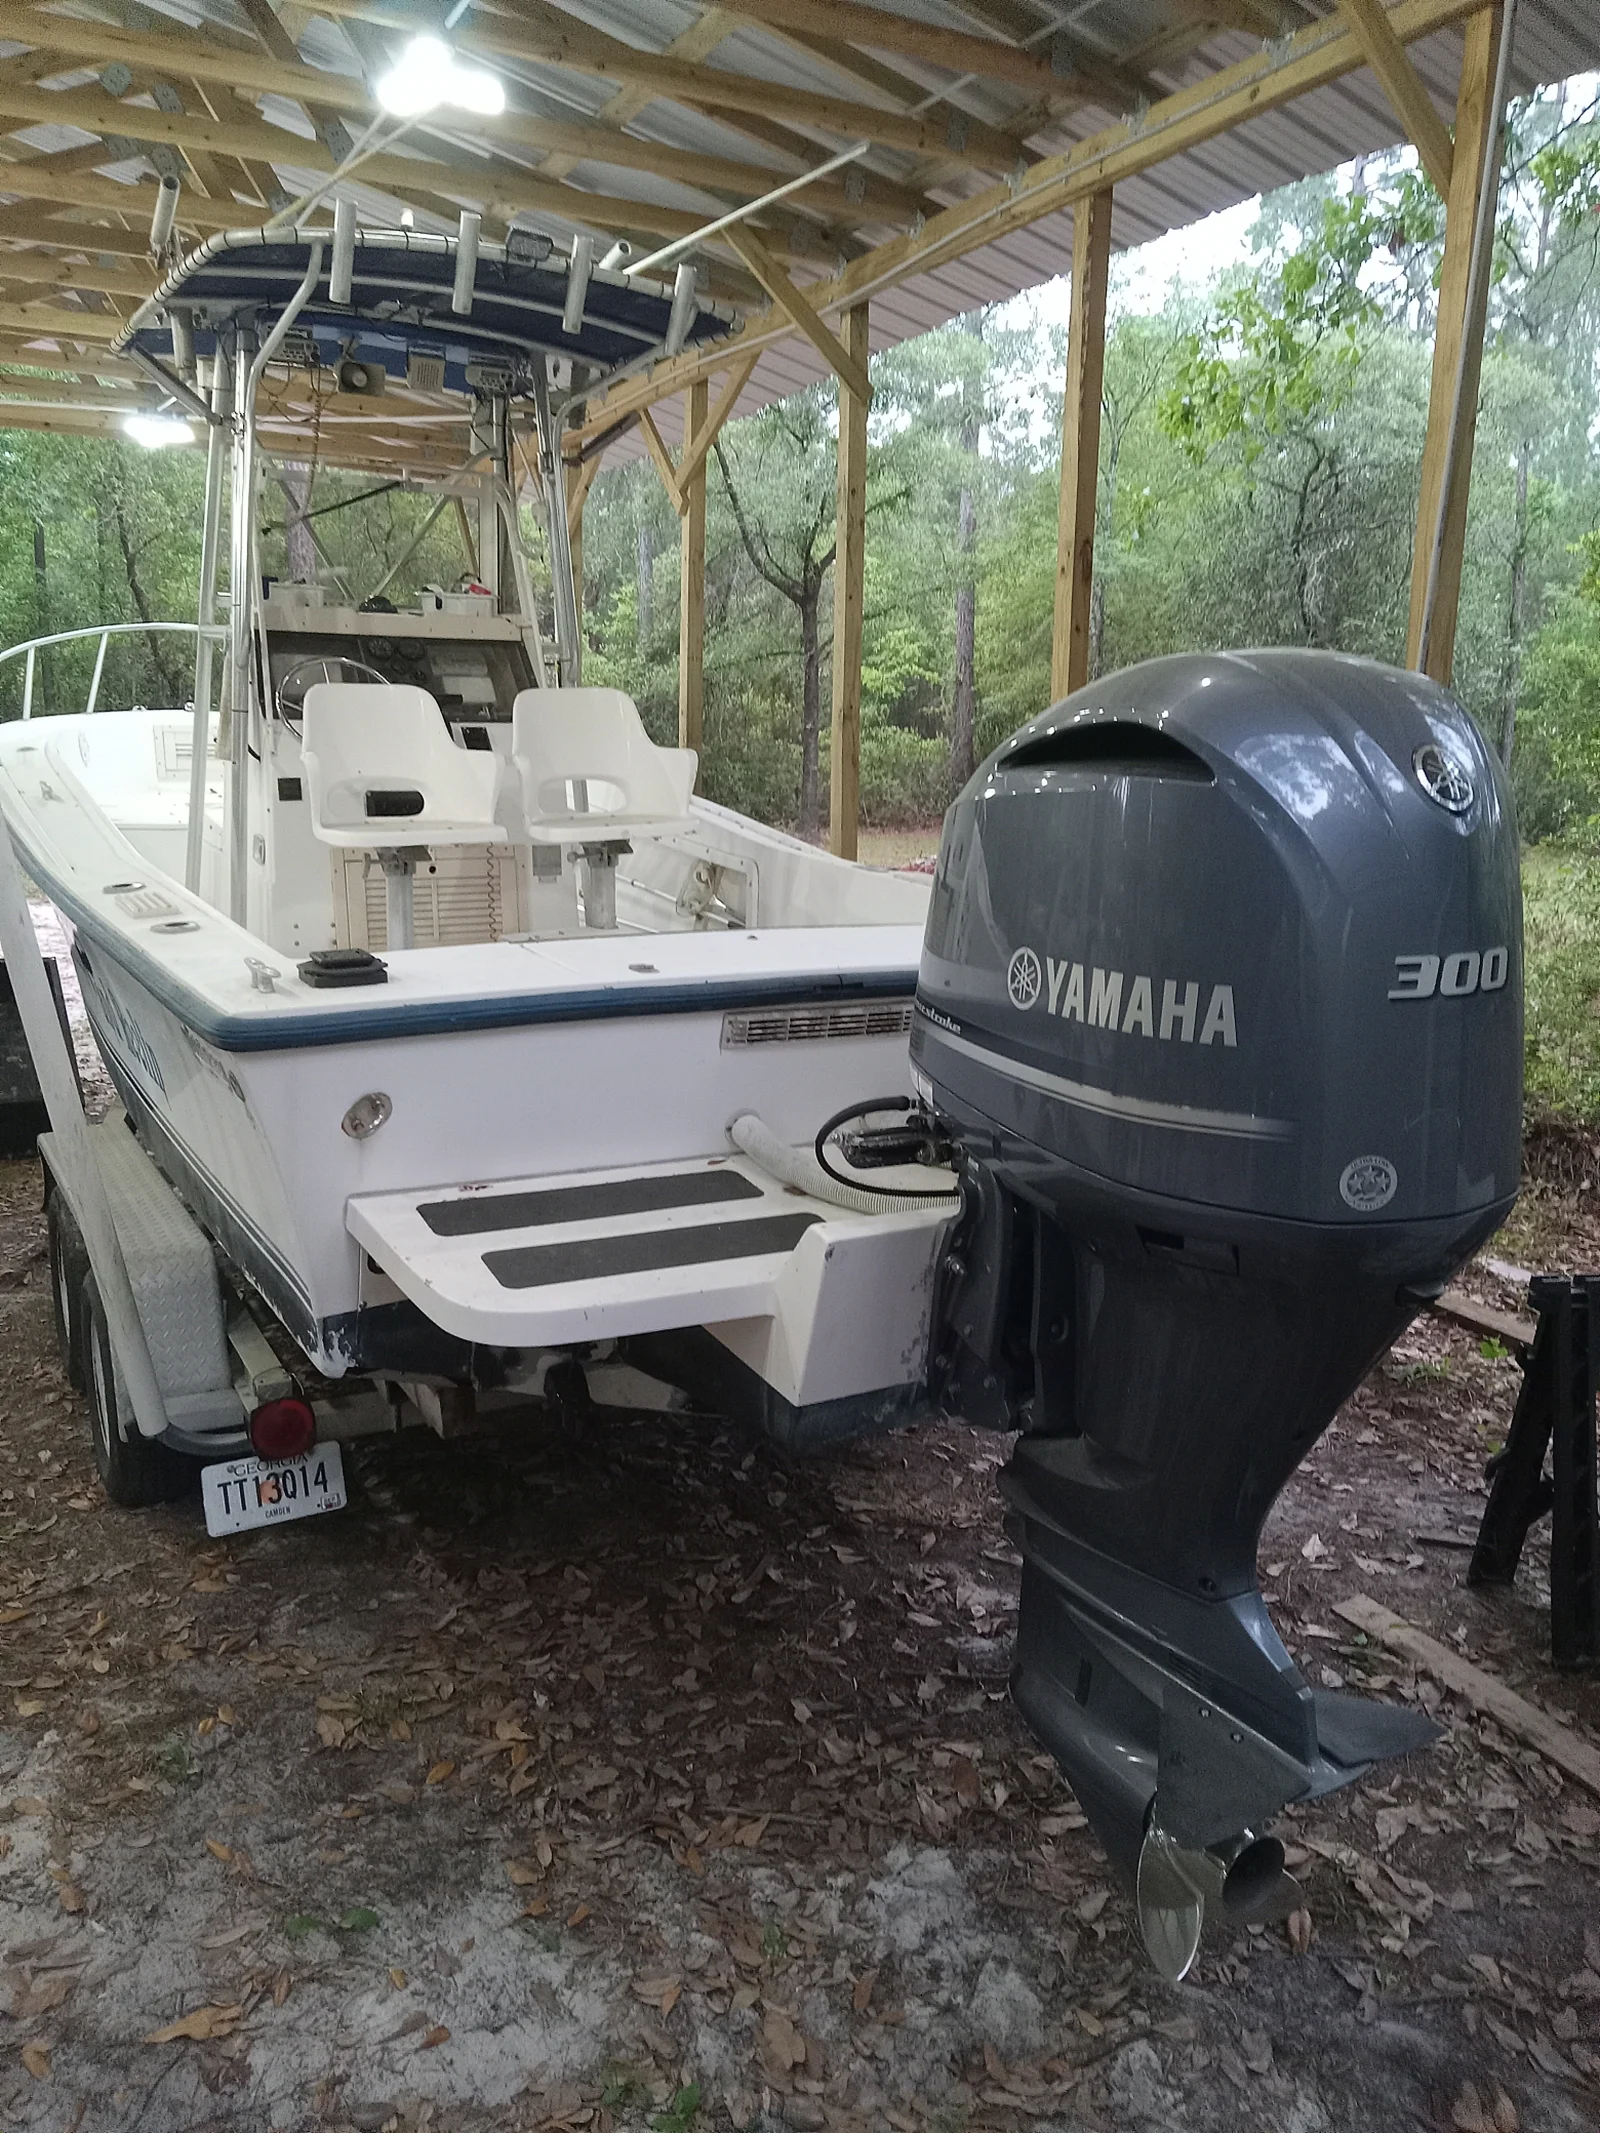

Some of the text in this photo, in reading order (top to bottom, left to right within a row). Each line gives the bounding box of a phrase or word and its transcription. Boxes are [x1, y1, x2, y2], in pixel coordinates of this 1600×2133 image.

[1387, 946, 1508, 999] 300
[1046, 956, 1238, 1047] YAMAHA
[217, 1461, 328, 1515] TT13Q14
[265, 1507, 291, 1519] CAMDEN
